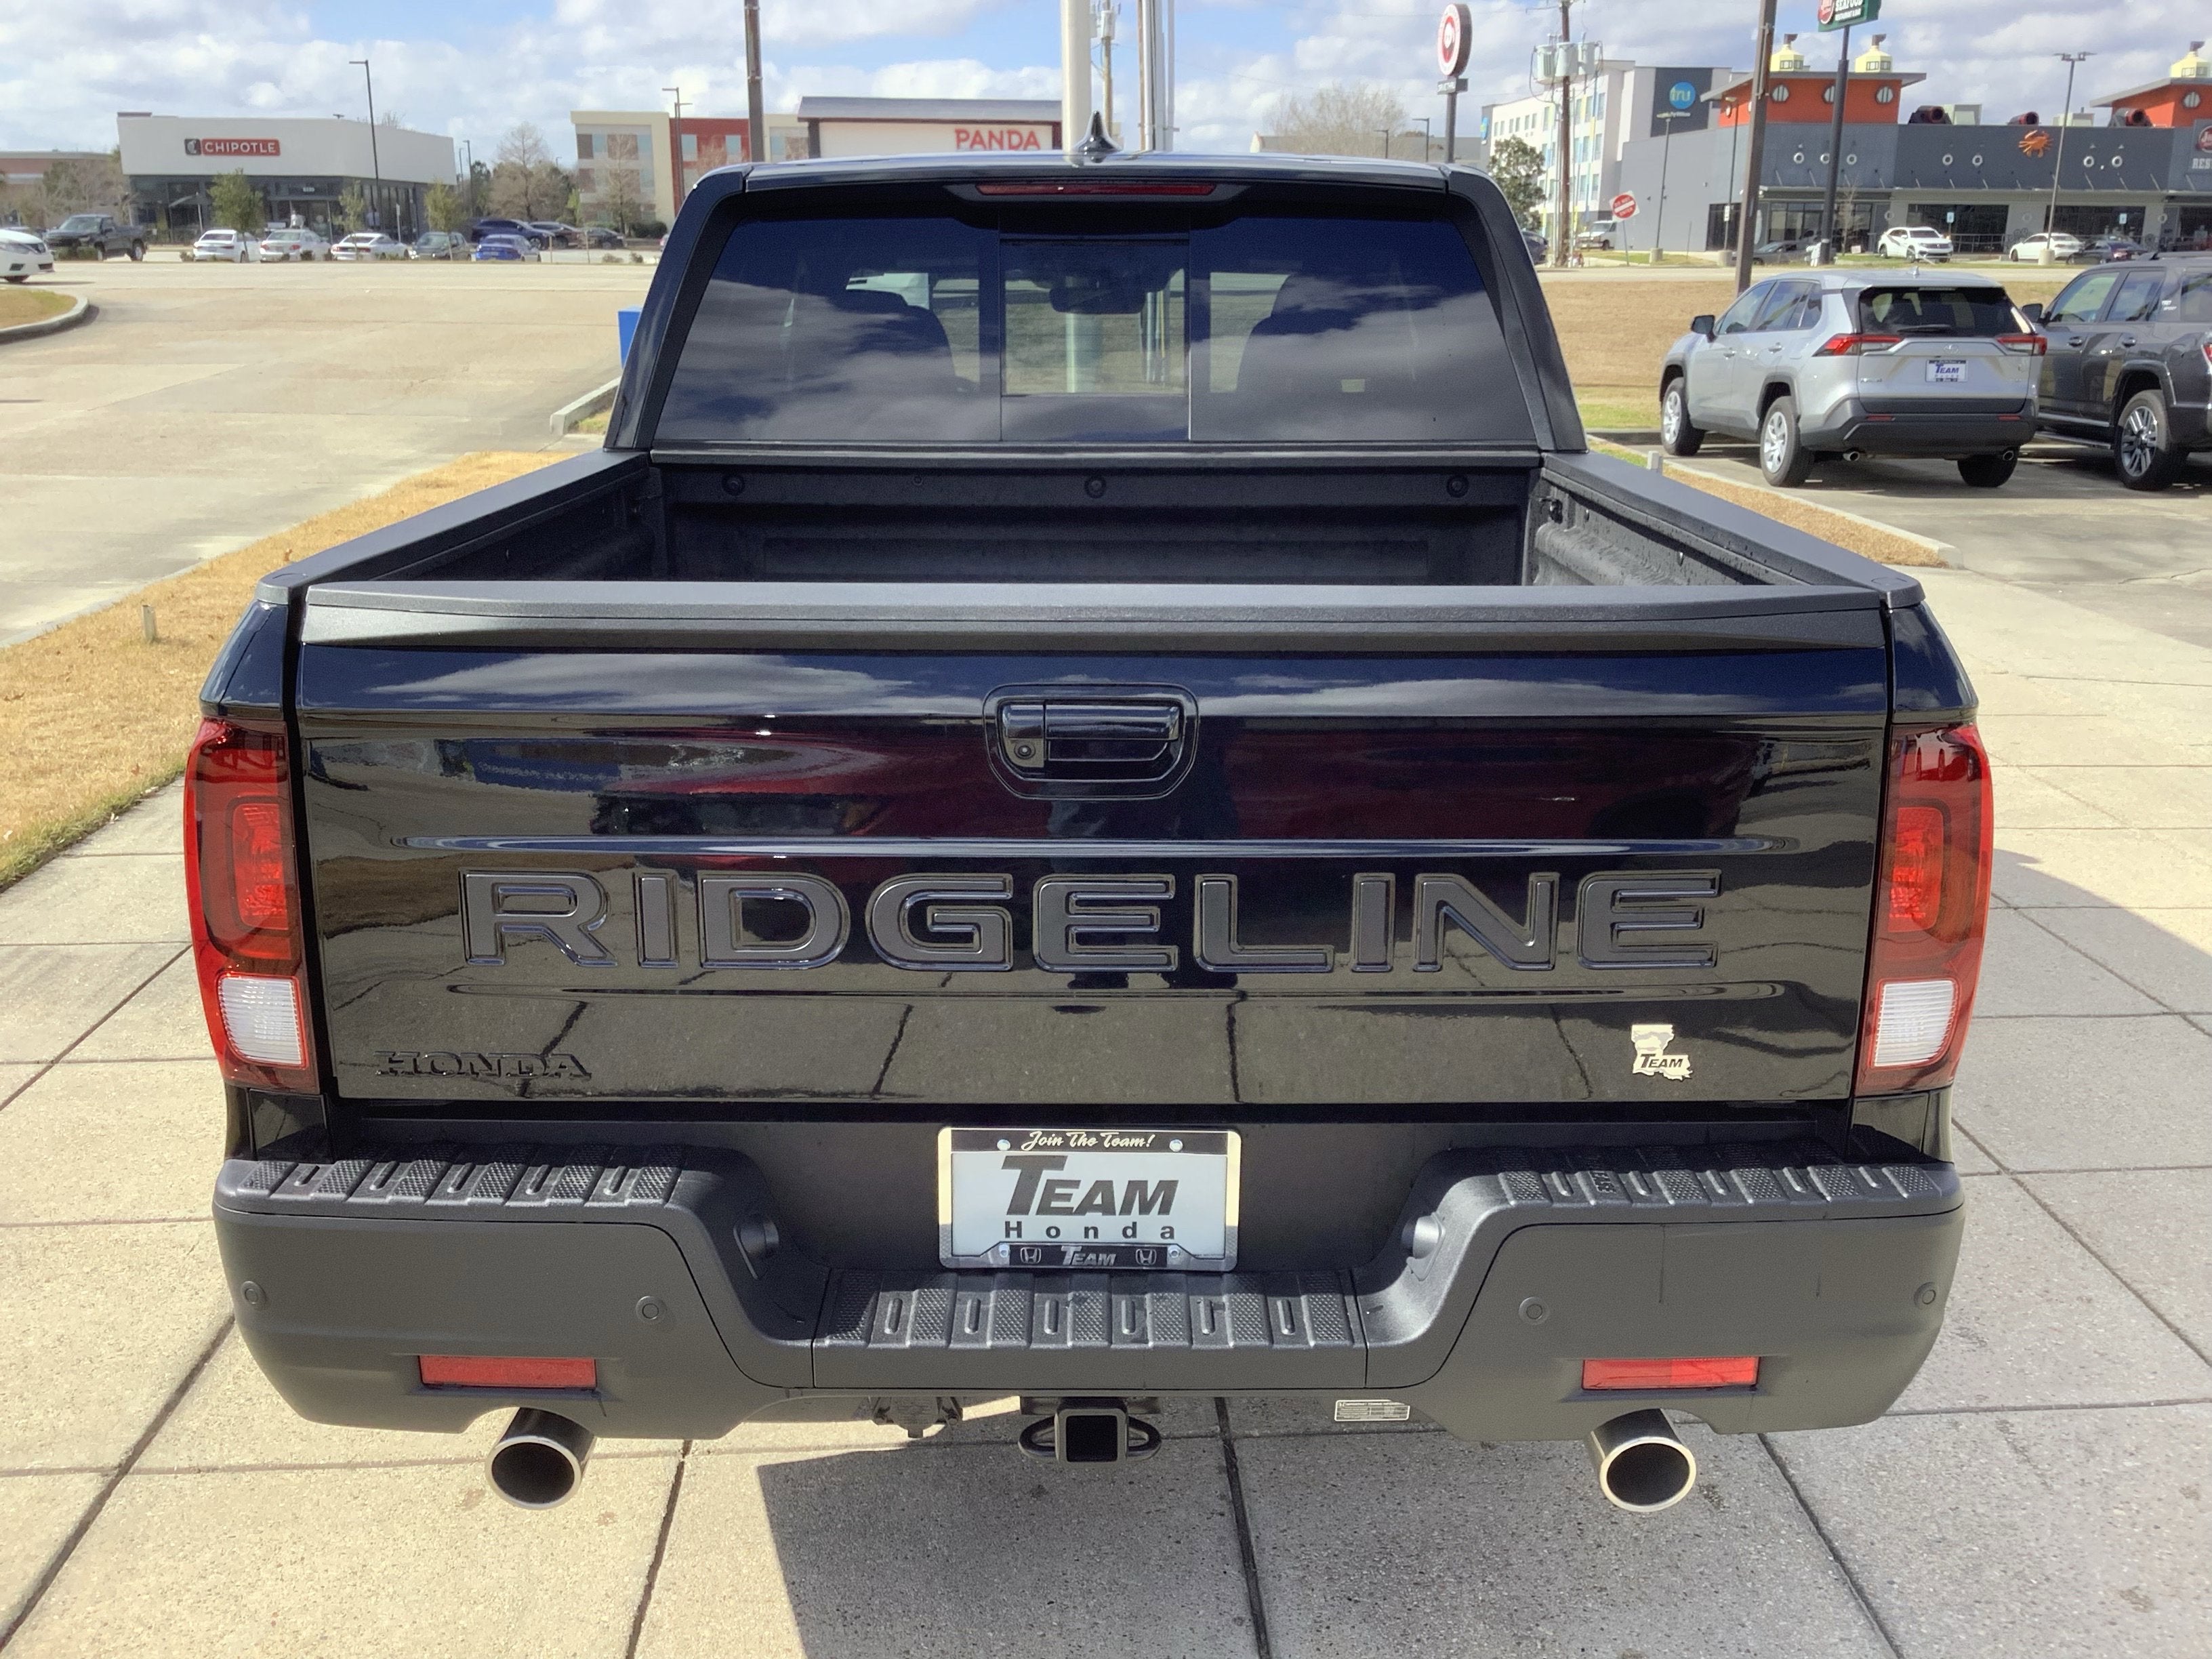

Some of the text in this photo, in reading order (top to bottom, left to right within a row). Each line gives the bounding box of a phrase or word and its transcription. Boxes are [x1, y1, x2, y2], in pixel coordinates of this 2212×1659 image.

[205, 142, 276, 152] CHIPOTLE
[954, 128, 1040, 150] PANDA
[2192, 158, 2212, 169] RES
[1936, 362, 1959, 373] TEAM
[458, 869, 1722, 973] RIDGELINE
[373, 1051, 592, 1078] HONDA
[1641, 1053, 1683, 1068] TEAM
[1021, 1130, 1155, 1151] Join The Team!
[1001, 1155, 1179, 1216] TEAM
[1005, 1221, 1175, 1240] Honda
[1061, 1246, 1116, 1266] TEAM
